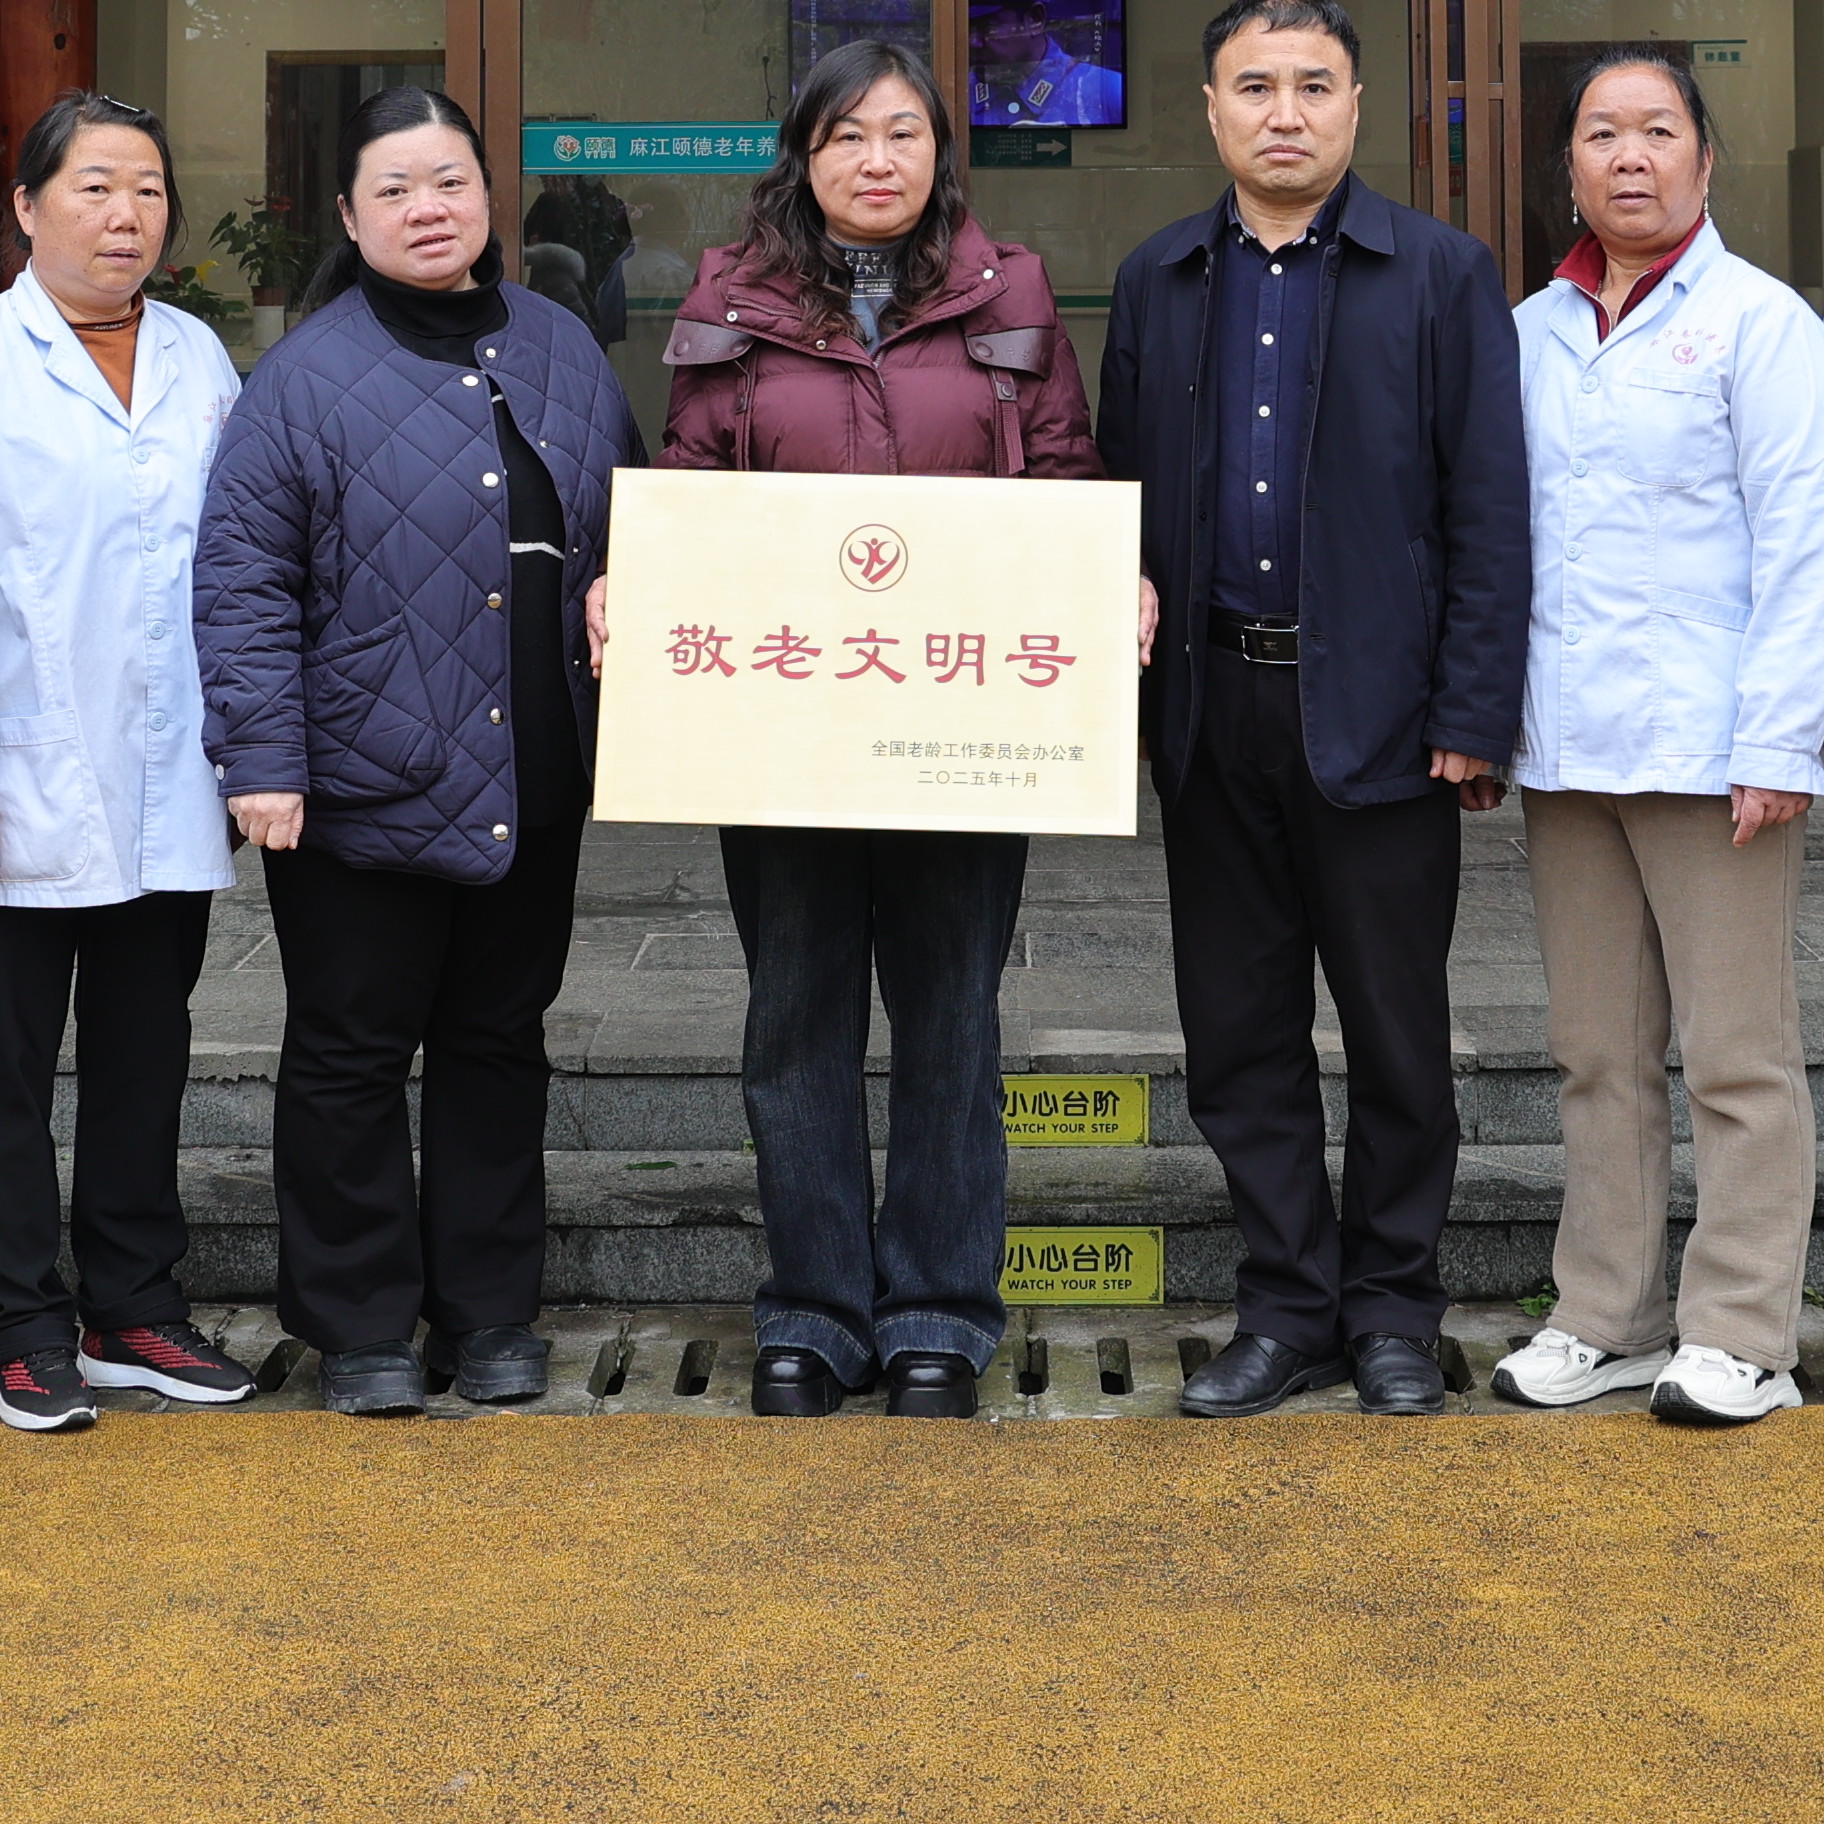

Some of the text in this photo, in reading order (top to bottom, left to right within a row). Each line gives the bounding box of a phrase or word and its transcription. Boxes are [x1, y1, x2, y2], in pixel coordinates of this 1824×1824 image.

[665, 623, 1078, 688] 敬老文明号
[871, 740, 1085, 762] 全国老龄工作委员会办公室
[1001, 1090, 1120, 1117] 小心台阶
[1004, 1123, 1119, 1133] WATCH YOUR STEP
[1006, 1243, 1133, 1272] 小心台阶
[1007, 1279, 1132, 1290] WATCH YOUR STEP
